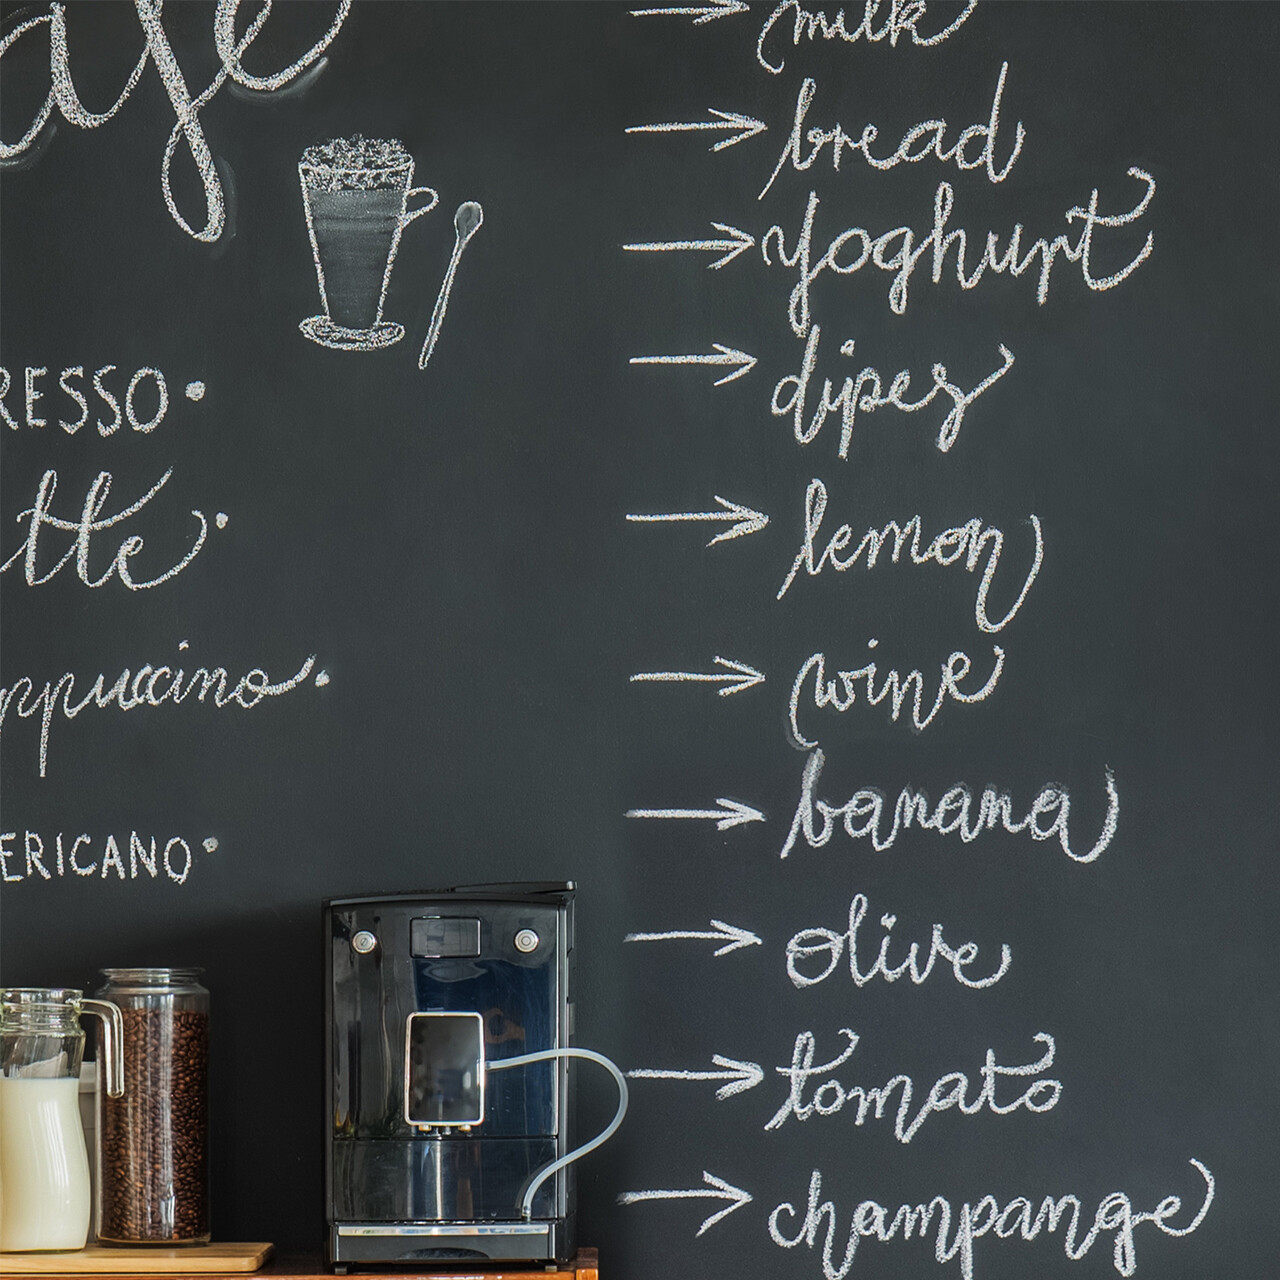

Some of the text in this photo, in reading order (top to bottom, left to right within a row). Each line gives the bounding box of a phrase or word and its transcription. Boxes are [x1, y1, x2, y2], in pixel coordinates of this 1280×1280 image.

[756, 0, 978, 75] milk
[758, 62, 1027, 200] bread
[762, 167, 1156, 336] yoghurt
[771, 325, 1015, 460] dipes
[777, 478, 1044, 634] lemon
[787, 639, 1005, 749] wine
[780, 747, 1119, 864] banana
[785, 893, 1012, 990] olive
[764, 1029, 1064, 1144] tomato
